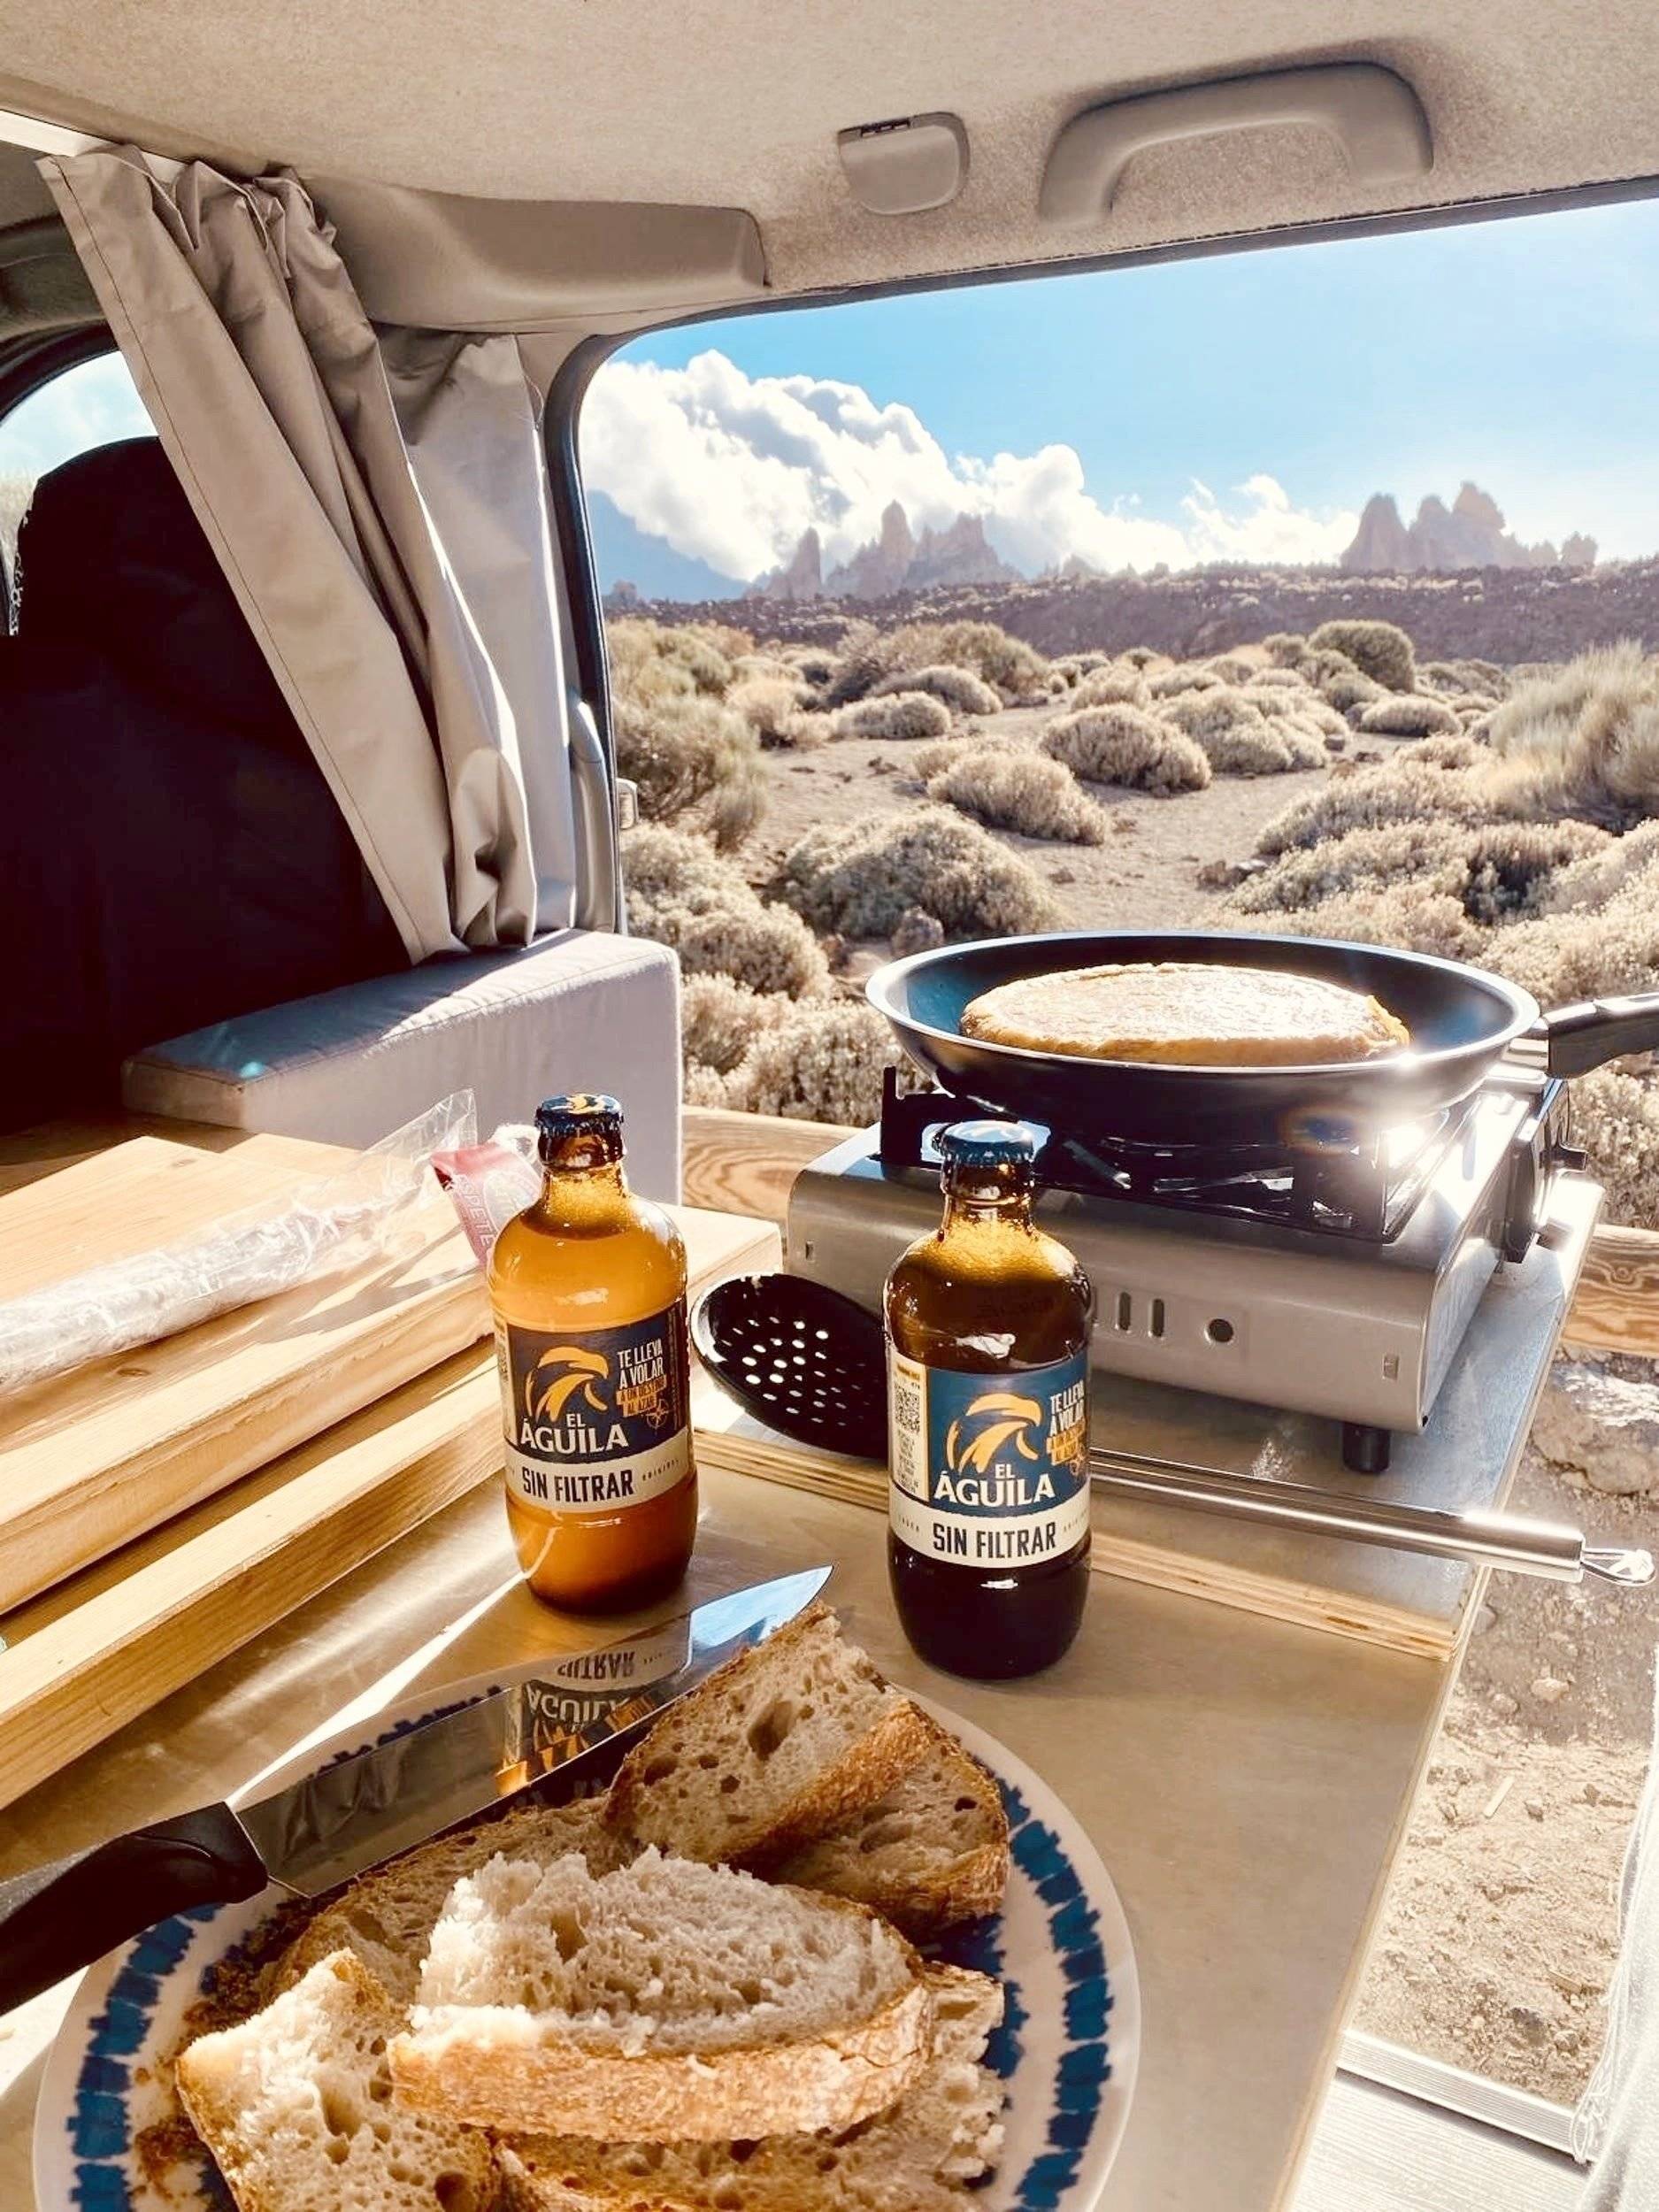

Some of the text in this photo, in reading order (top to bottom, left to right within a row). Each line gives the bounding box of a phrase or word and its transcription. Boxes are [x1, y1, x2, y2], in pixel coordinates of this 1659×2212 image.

[617, 1338, 663, 1369] TE LLEVA
[620, 1356, 664, 1390] A VOLAR
[566, 1413, 586, 1427] EL
[1050, 1393, 1063, 1415] TE
[521, 1418, 629, 1454] ÁGUILA
[1050, 1416, 1057, 1437] A
[522, 1467, 548, 1500] SIN
[555, 1470, 634, 1502] FILTRAR
[995, 1463, 1016, 1479] EL
[933, 1471, 1056, 1507] ÁGUILA
[933, 1523, 967, 1556] SIN
[976, 1522, 1056, 1559] FILTRAR
